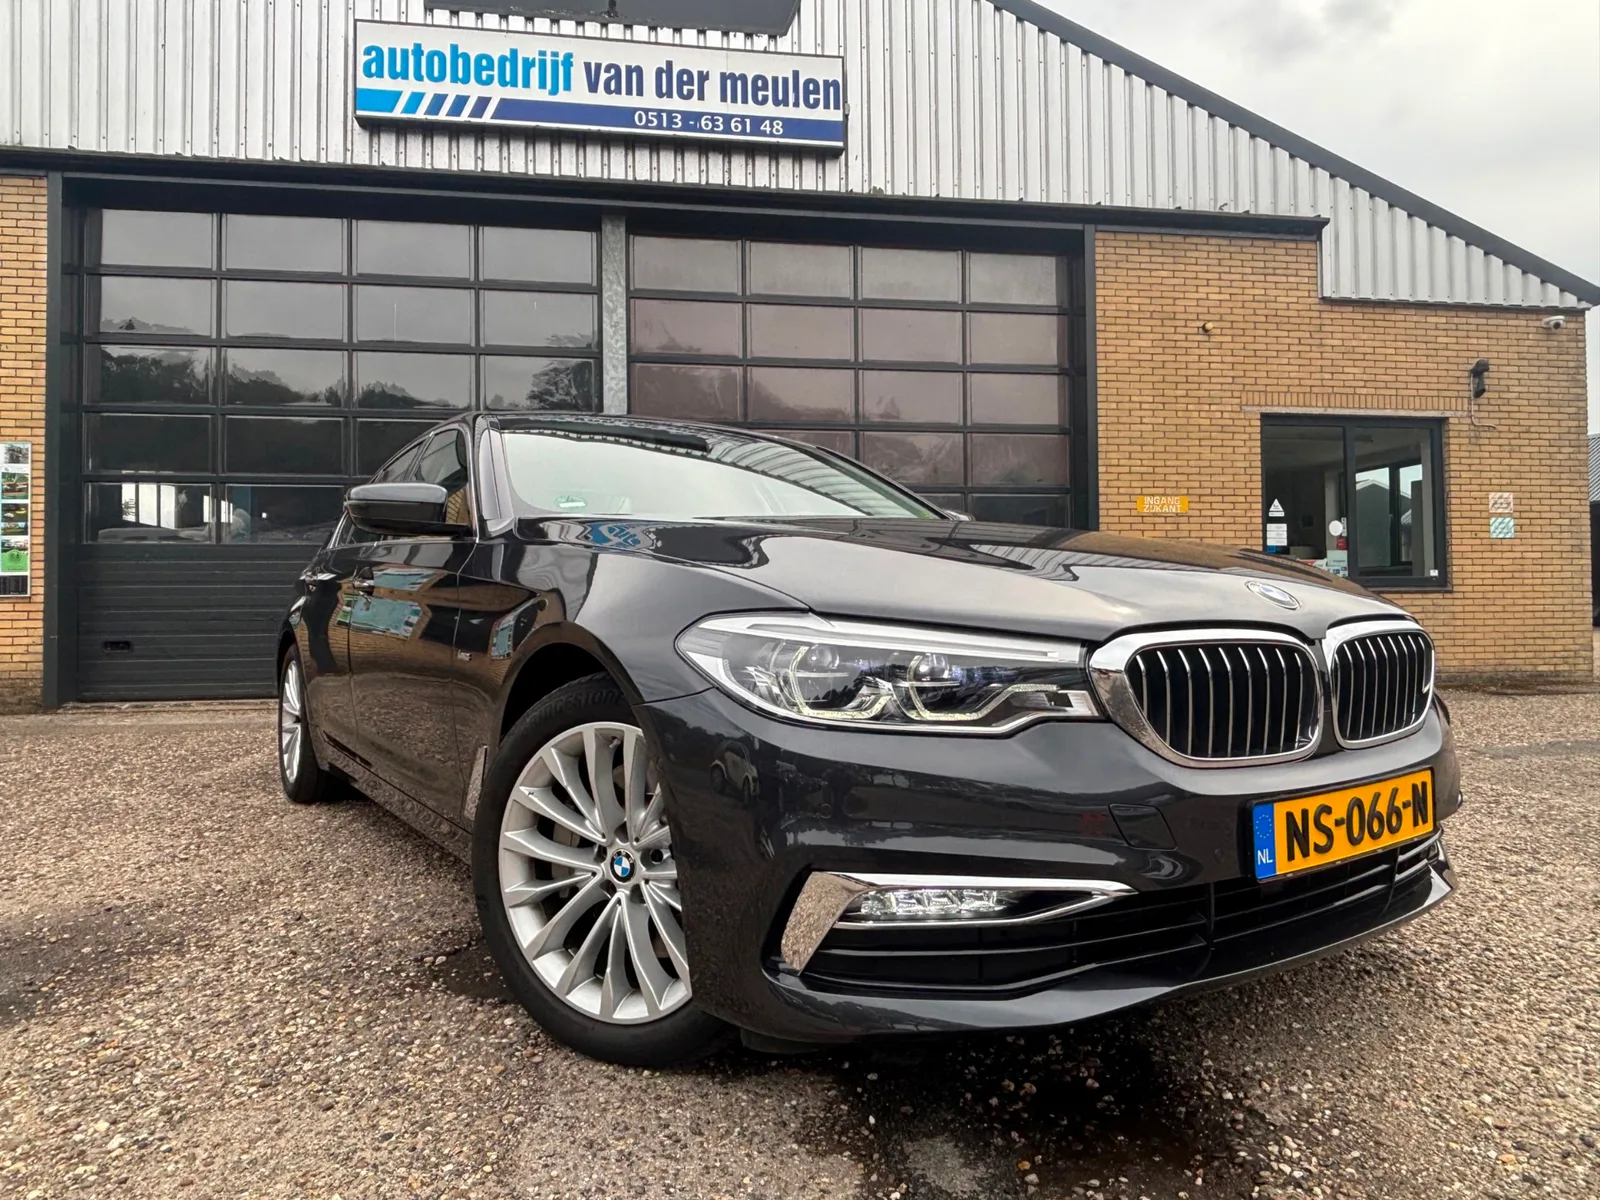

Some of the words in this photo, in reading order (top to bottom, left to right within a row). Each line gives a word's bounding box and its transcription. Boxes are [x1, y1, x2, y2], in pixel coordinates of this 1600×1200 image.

[362, 42, 574, 96] autobedrijf
[583, 61, 644, 97] van
[654, 60, 710, 102] der
[719, 69, 841, 111] meulen
[634, 110, 683, 128] 0513
[700, 115, 724, 132] 63
[730, 118, 751, 133] 61
[759, 120, 784, 135] 48
[1143, 495, 1181, 505] INGANG
[1285, 780, 1429, 862] NS-066-N
[1257, 848, 1274, 865] NL
